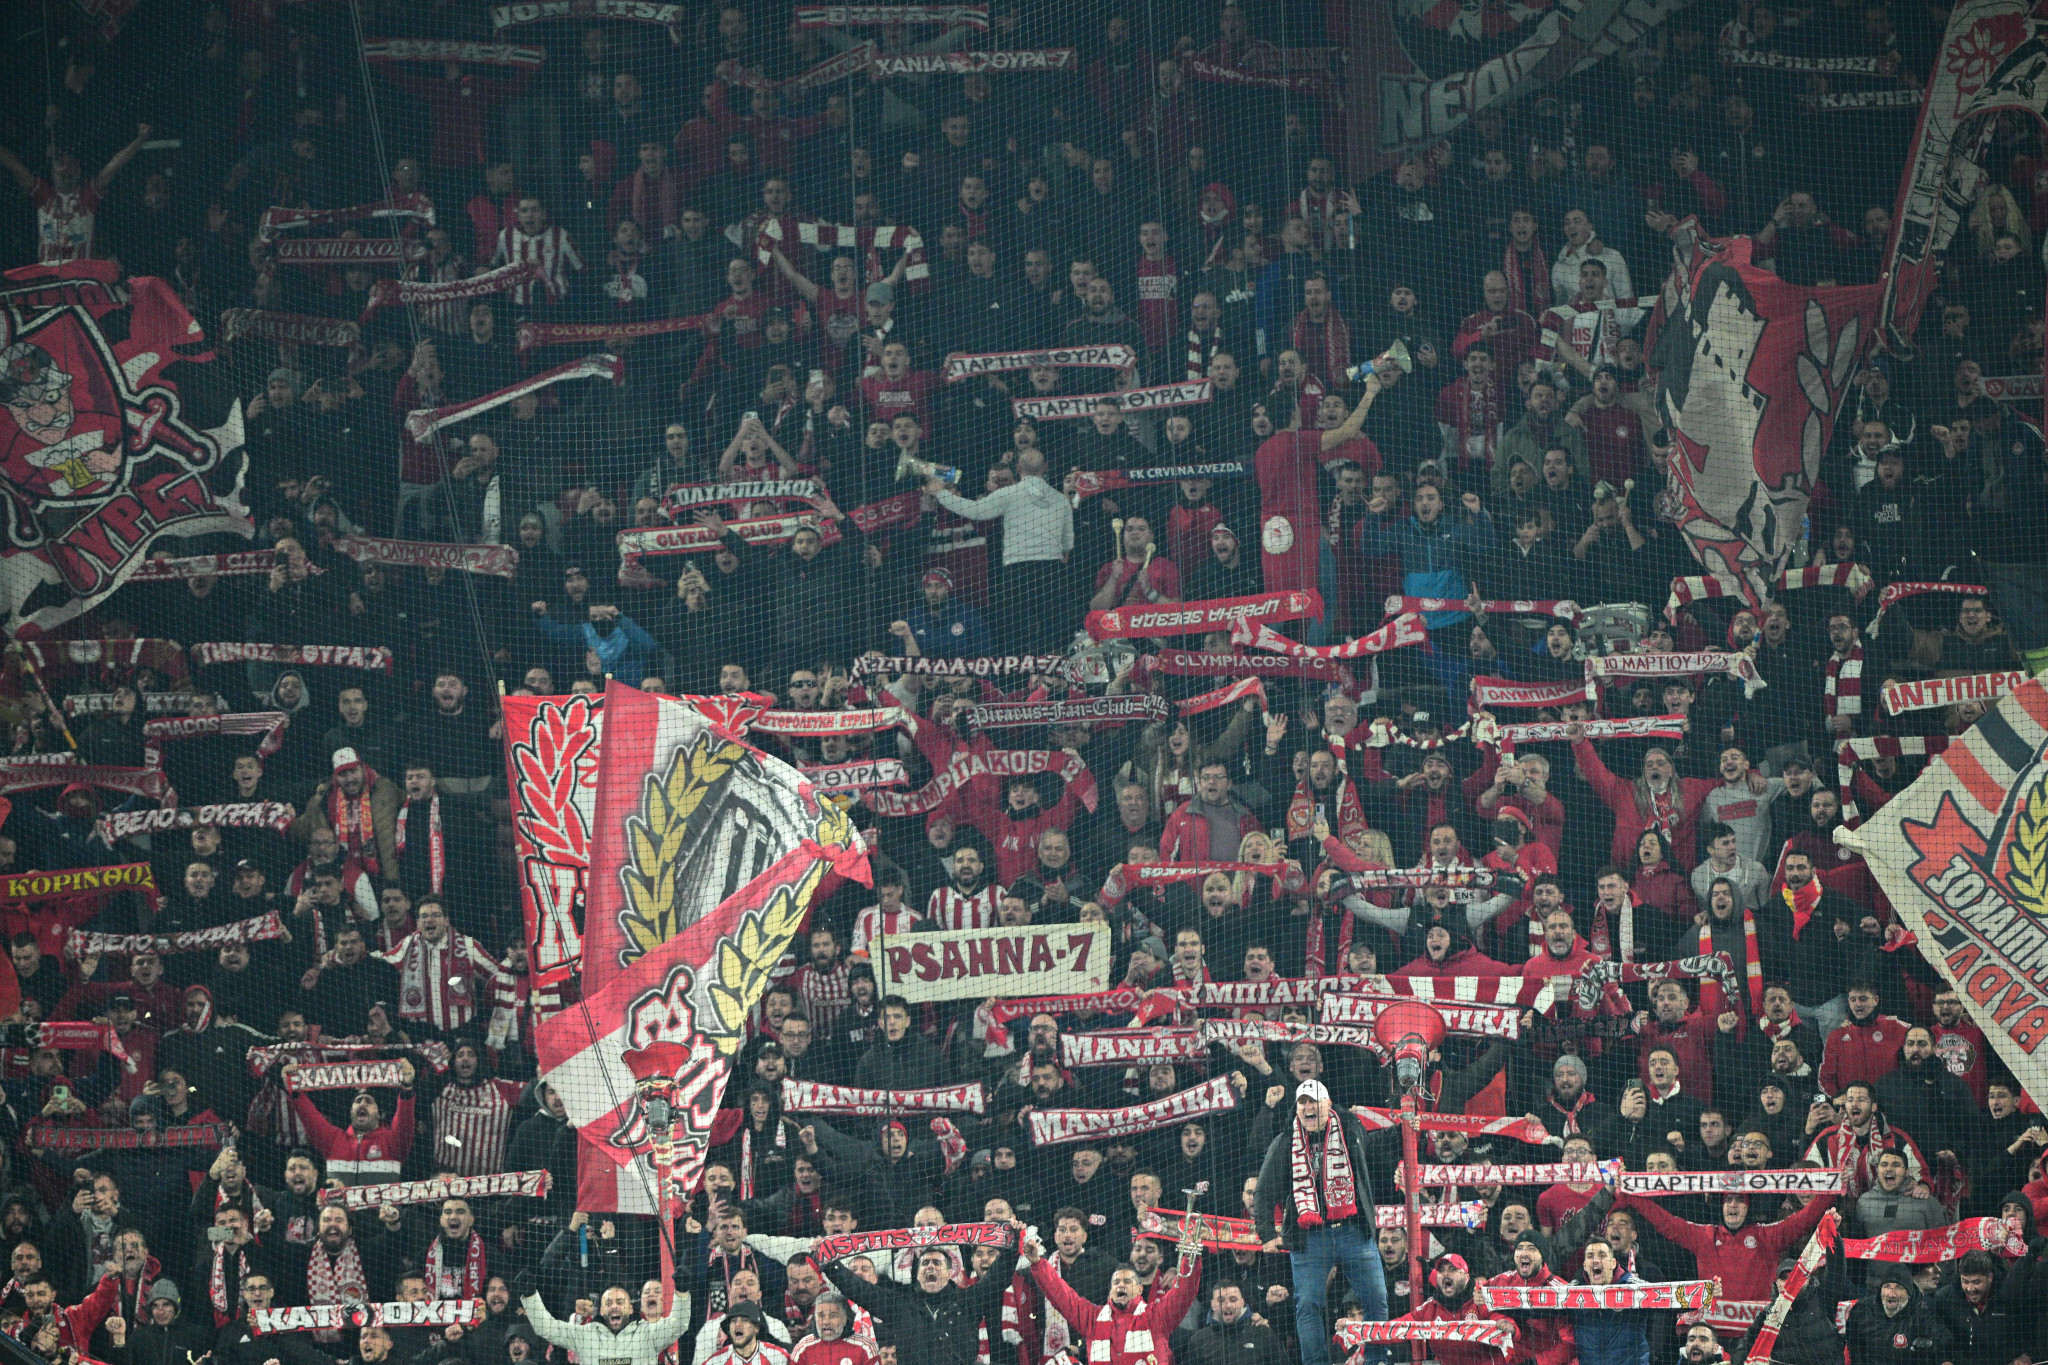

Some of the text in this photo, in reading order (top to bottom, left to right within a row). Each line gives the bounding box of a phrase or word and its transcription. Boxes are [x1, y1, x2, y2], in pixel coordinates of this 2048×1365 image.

[990, 51, 1068, 69] ΘΥΡΑ-7
[1129, 470, 1142, 481] FK
[1193, 462, 1243, 477] ZVEZDA
[656, 525, 783, 546] GLYFAD CLUB
[1174, 653, 1328, 668] OLYMPIACOS FC
[1621, 657, 1687, 673] ΜΑΡΤΙΟΥ
[8, 863, 155, 892] ΚΟΡΙΝΘΟΣ
[887, 930, 1095, 985] PSAHNA-7
[1321, 992, 1519, 1038] ΜΑΤΙΚΑ
[783, 1079, 983, 1114] ΜΑΝΙΑΤΙΚΑ
[1030, 1075, 1232, 1145] ΜΑΝΙΑΤΙΚΑ
[1619, 1170, 1837, 1191] ΣΠΑΡΤΗ ΘΥΡΑ-7
[937, 1224, 999, 1244] GATE
[1490, 1284, 1674, 1308] ΒΟΛΟΣ
